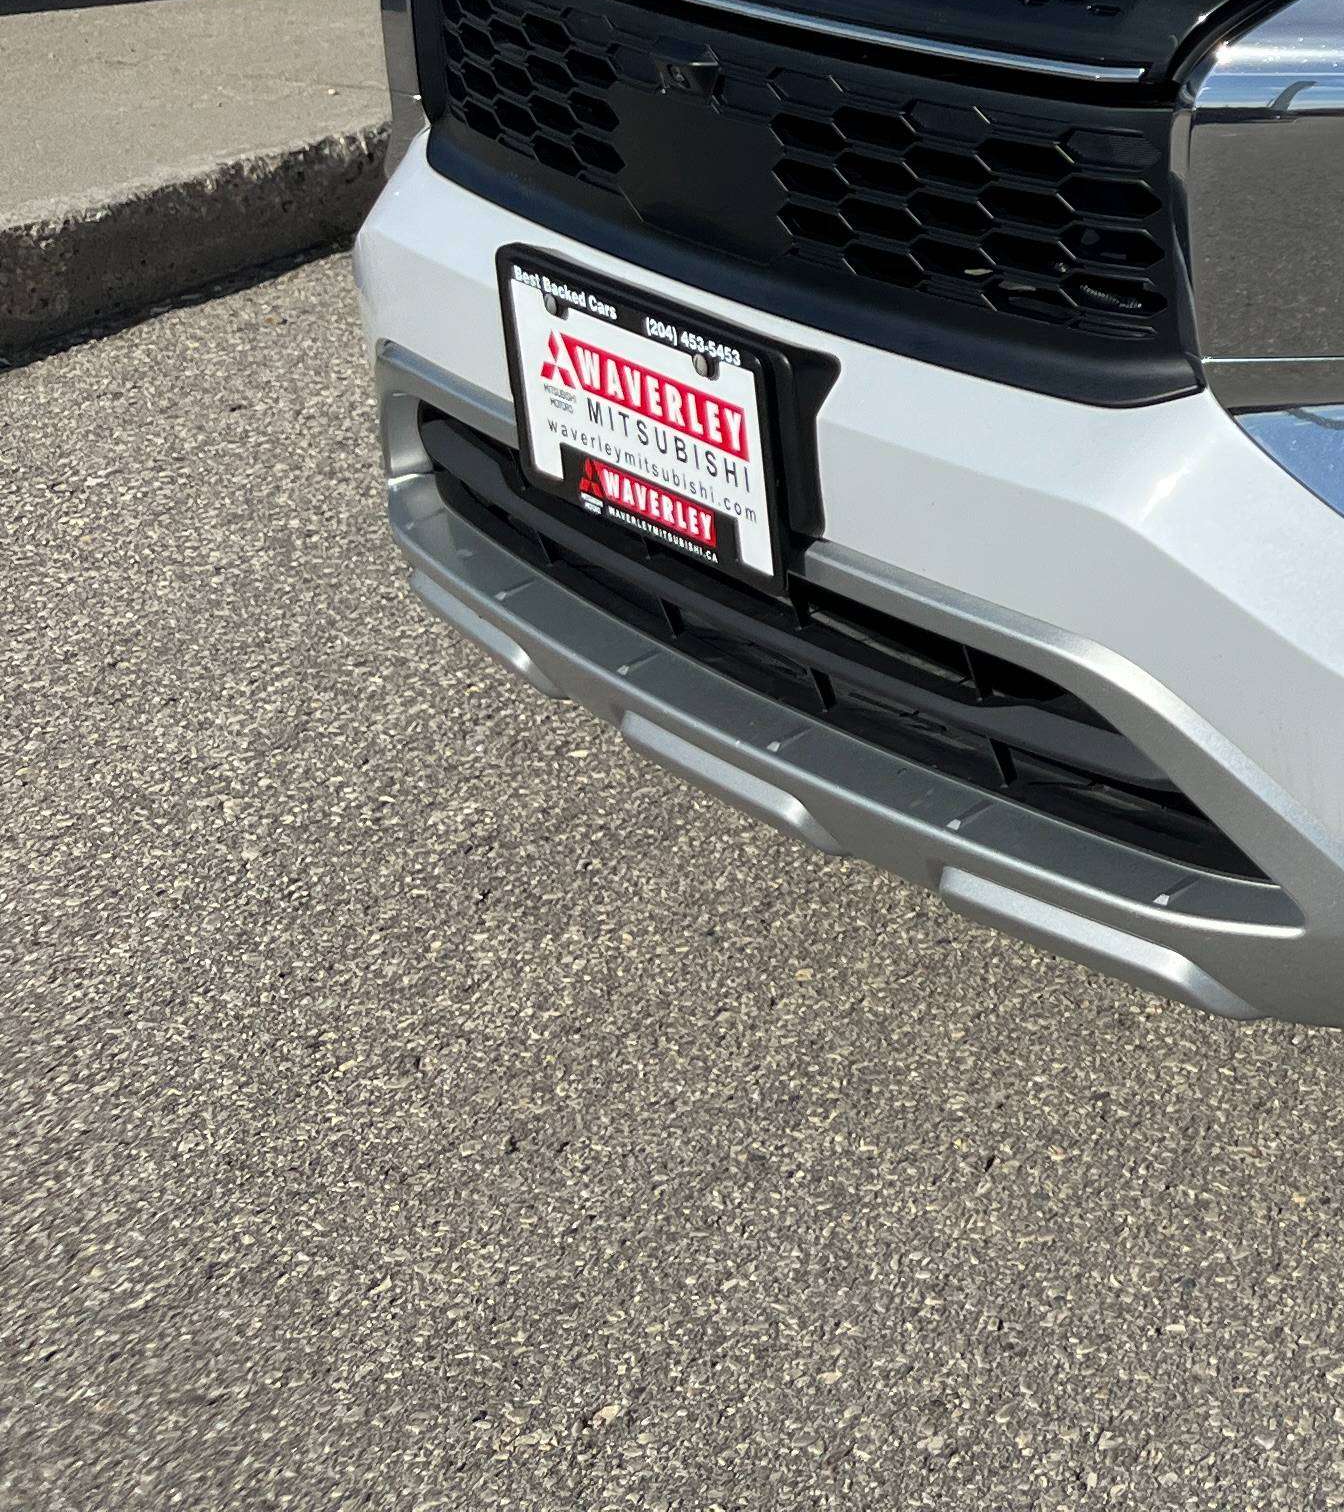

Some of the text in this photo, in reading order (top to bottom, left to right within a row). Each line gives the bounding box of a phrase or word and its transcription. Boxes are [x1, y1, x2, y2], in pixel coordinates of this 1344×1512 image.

[513, 264, 741, 367] Best Backed Cars (204) 453-5453
[576, 344, 744, 453] WAVERLEY
[586, 397, 751, 494] MITSUBISHI
[547, 418, 758, 524] waverleymitsubishi.com
[601, 467, 714, 542] WAVERLEY
[607, 505, 719, 564] WAVERLEYMITSUBISHI.CA
